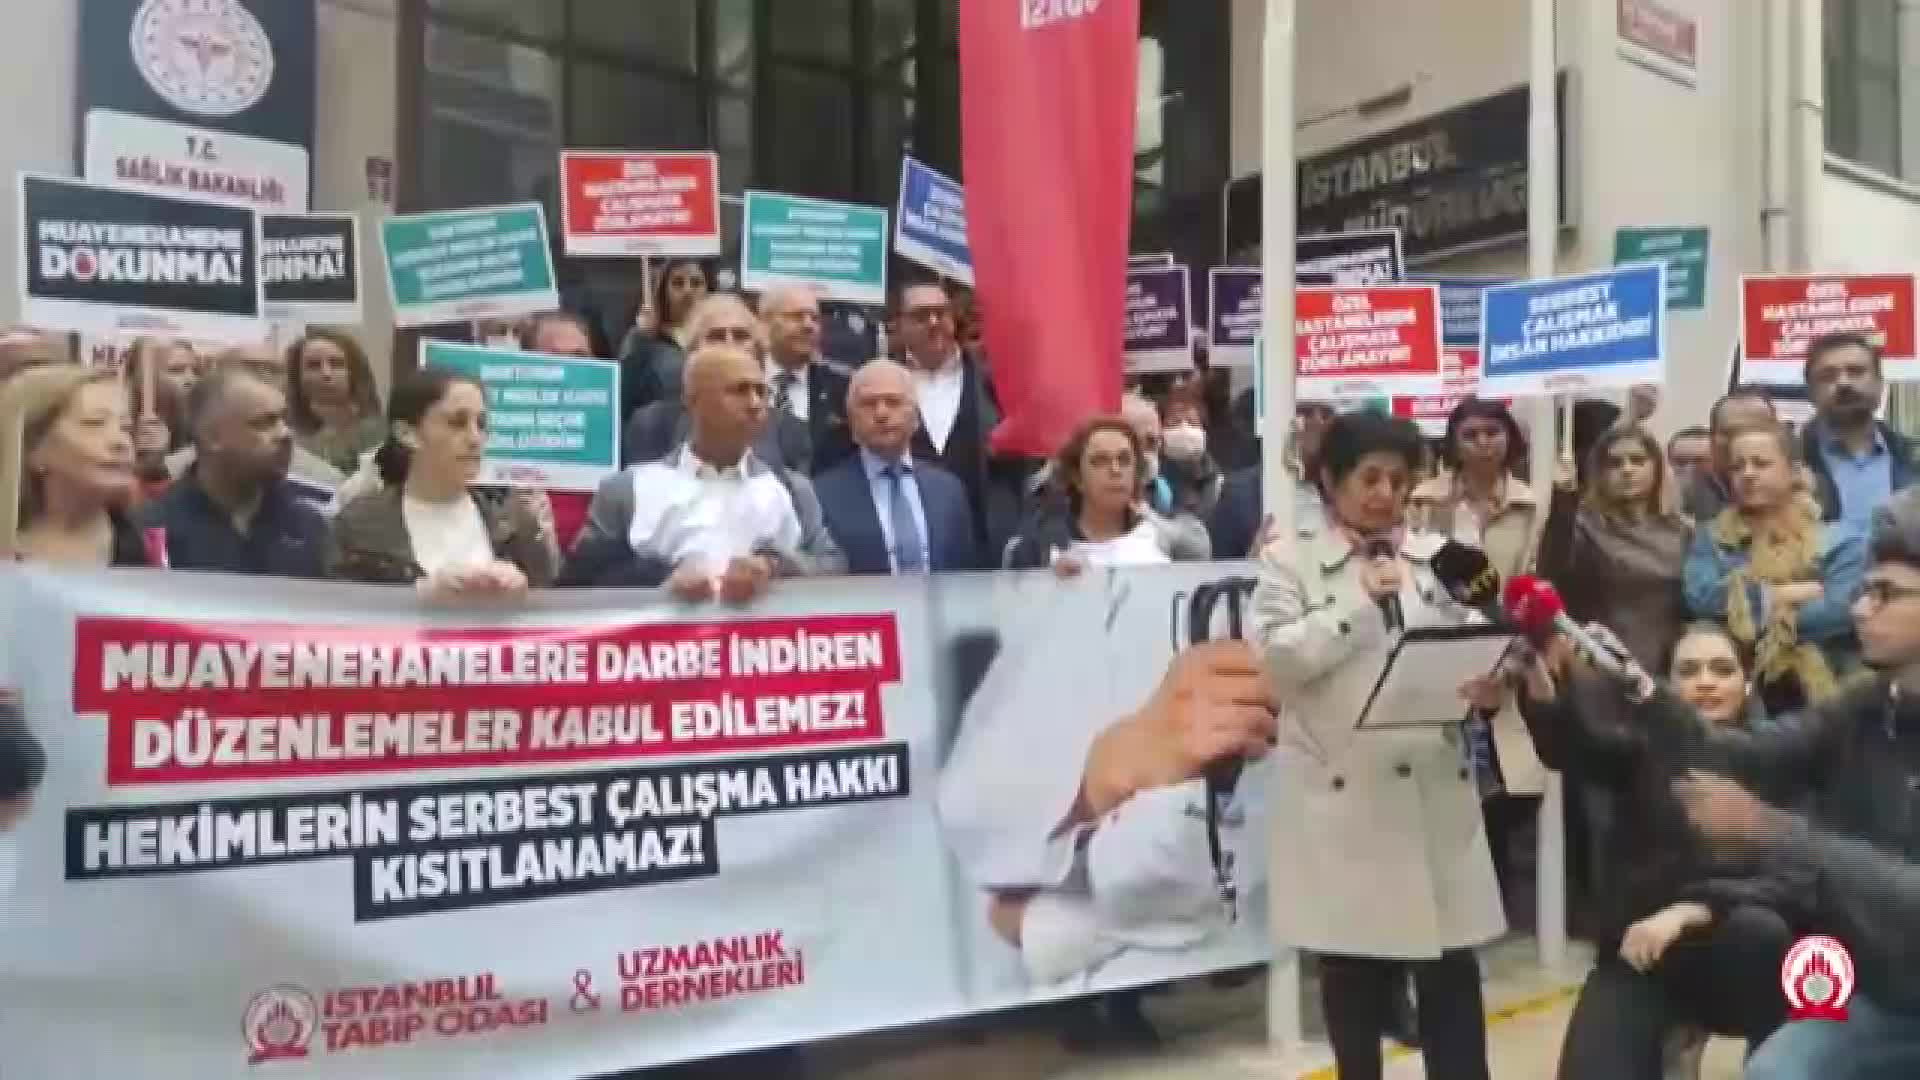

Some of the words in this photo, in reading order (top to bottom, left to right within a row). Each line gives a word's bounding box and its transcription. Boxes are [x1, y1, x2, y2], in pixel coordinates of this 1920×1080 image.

[40, 246, 244, 284] DOKUNMA!
[101, 637, 590, 692] MUAYENEHANELERE
[597, 638, 721, 684] DARBE
[729, 629, 883, 678] İNDİREN
[132, 706, 521, 769] DÜZENLEMELER
[529, 699, 665, 749] KABUL
[670, 692, 867, 741] EDİLEMEZ!
[83, 793, 398, 871] HEKİMLERİN
[407, 784, 595, 840] SERBEST
[606, 770, 776, 827] ÇALIŞMA
[782, 756, 899, 801] HAKKI
[371, 829, 706, 904] KISITLANAMAZ!
[616, 928, 784, 978] UZMANLIK
[620, 948, 806, 1013] DERNEKLERİ
[434, 997, 549, 1036] ODASI
[569, 968, 601, 1013] &
